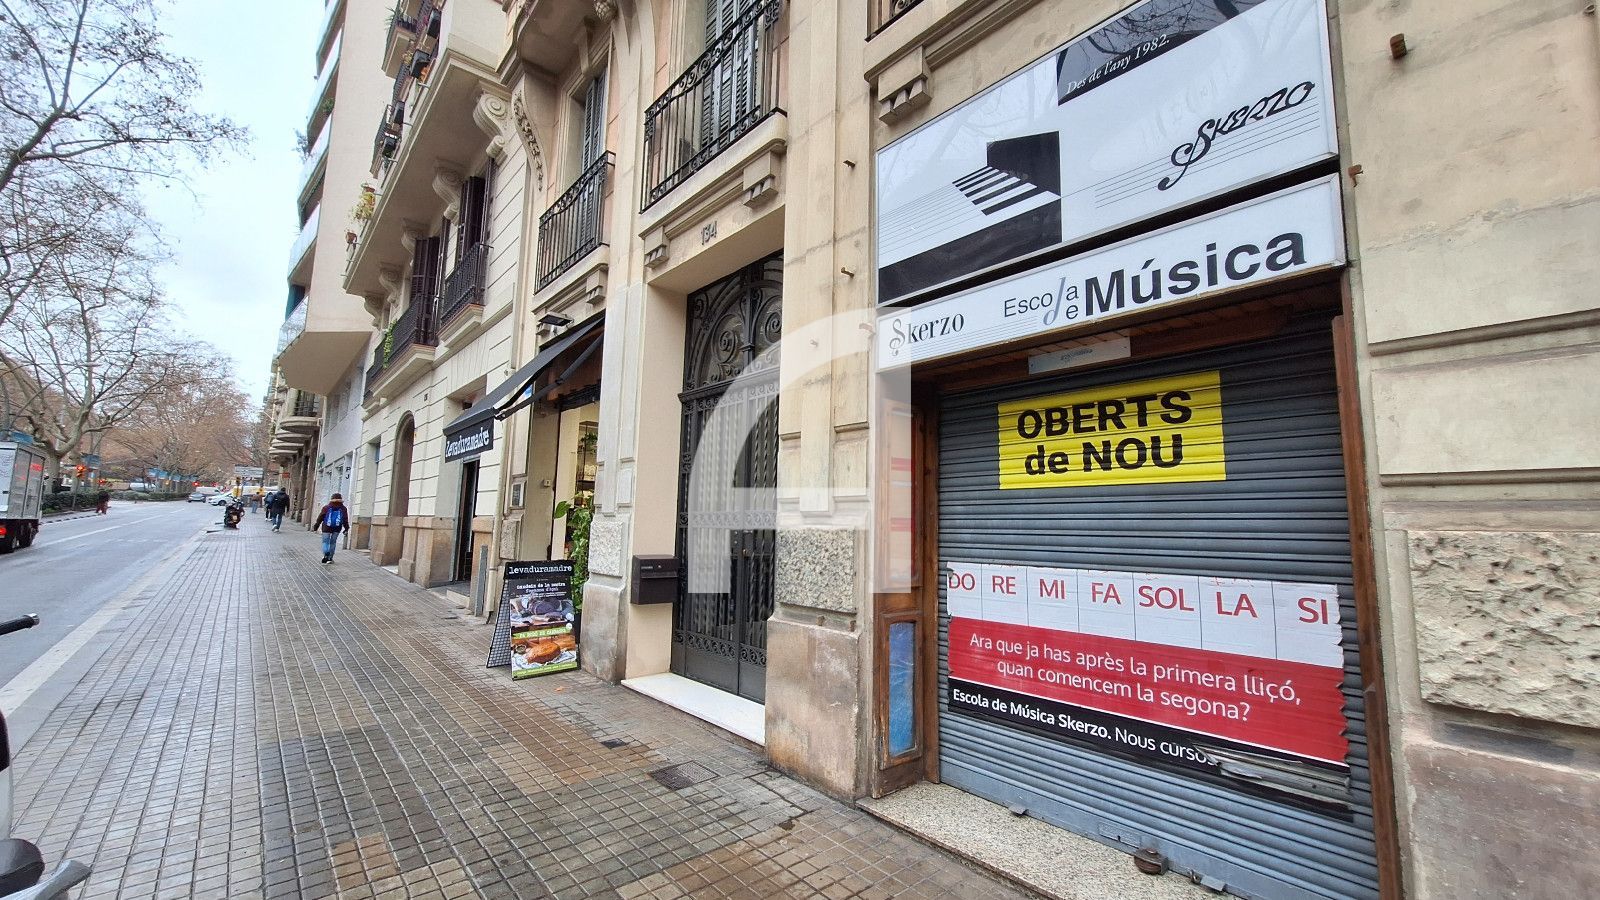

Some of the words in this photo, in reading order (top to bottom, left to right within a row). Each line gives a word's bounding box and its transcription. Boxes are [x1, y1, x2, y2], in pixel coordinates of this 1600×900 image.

[1065, 76, 1086, 95] Des
[1088, 68, 1102, 83] de
[1134, 34, 1170, 60] 1982.
[1084, 230, 1307, 318] Música
[889, 313, 965, 356] Skerzo
[1016, 390, 1193, 440] OBERTS
[1024, 445, 1070, 476] de
[1082, 433, 1184, 473] NOU
[508, 564, 573, 575] levaduramadre
[949, 572, 976, 591] DO
[992, 575, 1017, 595] RE
[1039, 578, 1066, 600] MI
[1091, 582, 1122, 605] FA
[1138, 585, 1195, 612] SOL
[1216, 591, 1258, 619] LA
[1297, 597, 1329, 625] SI
[970, 632, 993, 650] Ara
[996, 639, 1023, 656] que
[1025, 641, 1039, 660] ja
[1043, 643, 1071, 663] has
[1075, 651, 1125, 672] après
[1130, 656, 1147, 676] la
[1153, 663, 1236, 691] primera
[1244, 674, 1302, 706] lliçó,
[997, 660, 1033, 679] quan
[1037, 667, 1132, 698] comencem
[1136, 681, 1154, 703] la
[1160, 690, 1251, 722] segona?
[953, 688, 989, 707] Escola
[991, 696, 1008, 713] de
[1010, 701, 1055, 725] Música
[1058, 714, 1112, 740] Skerzo.
[1115, 727, 1156, 751] Nous
